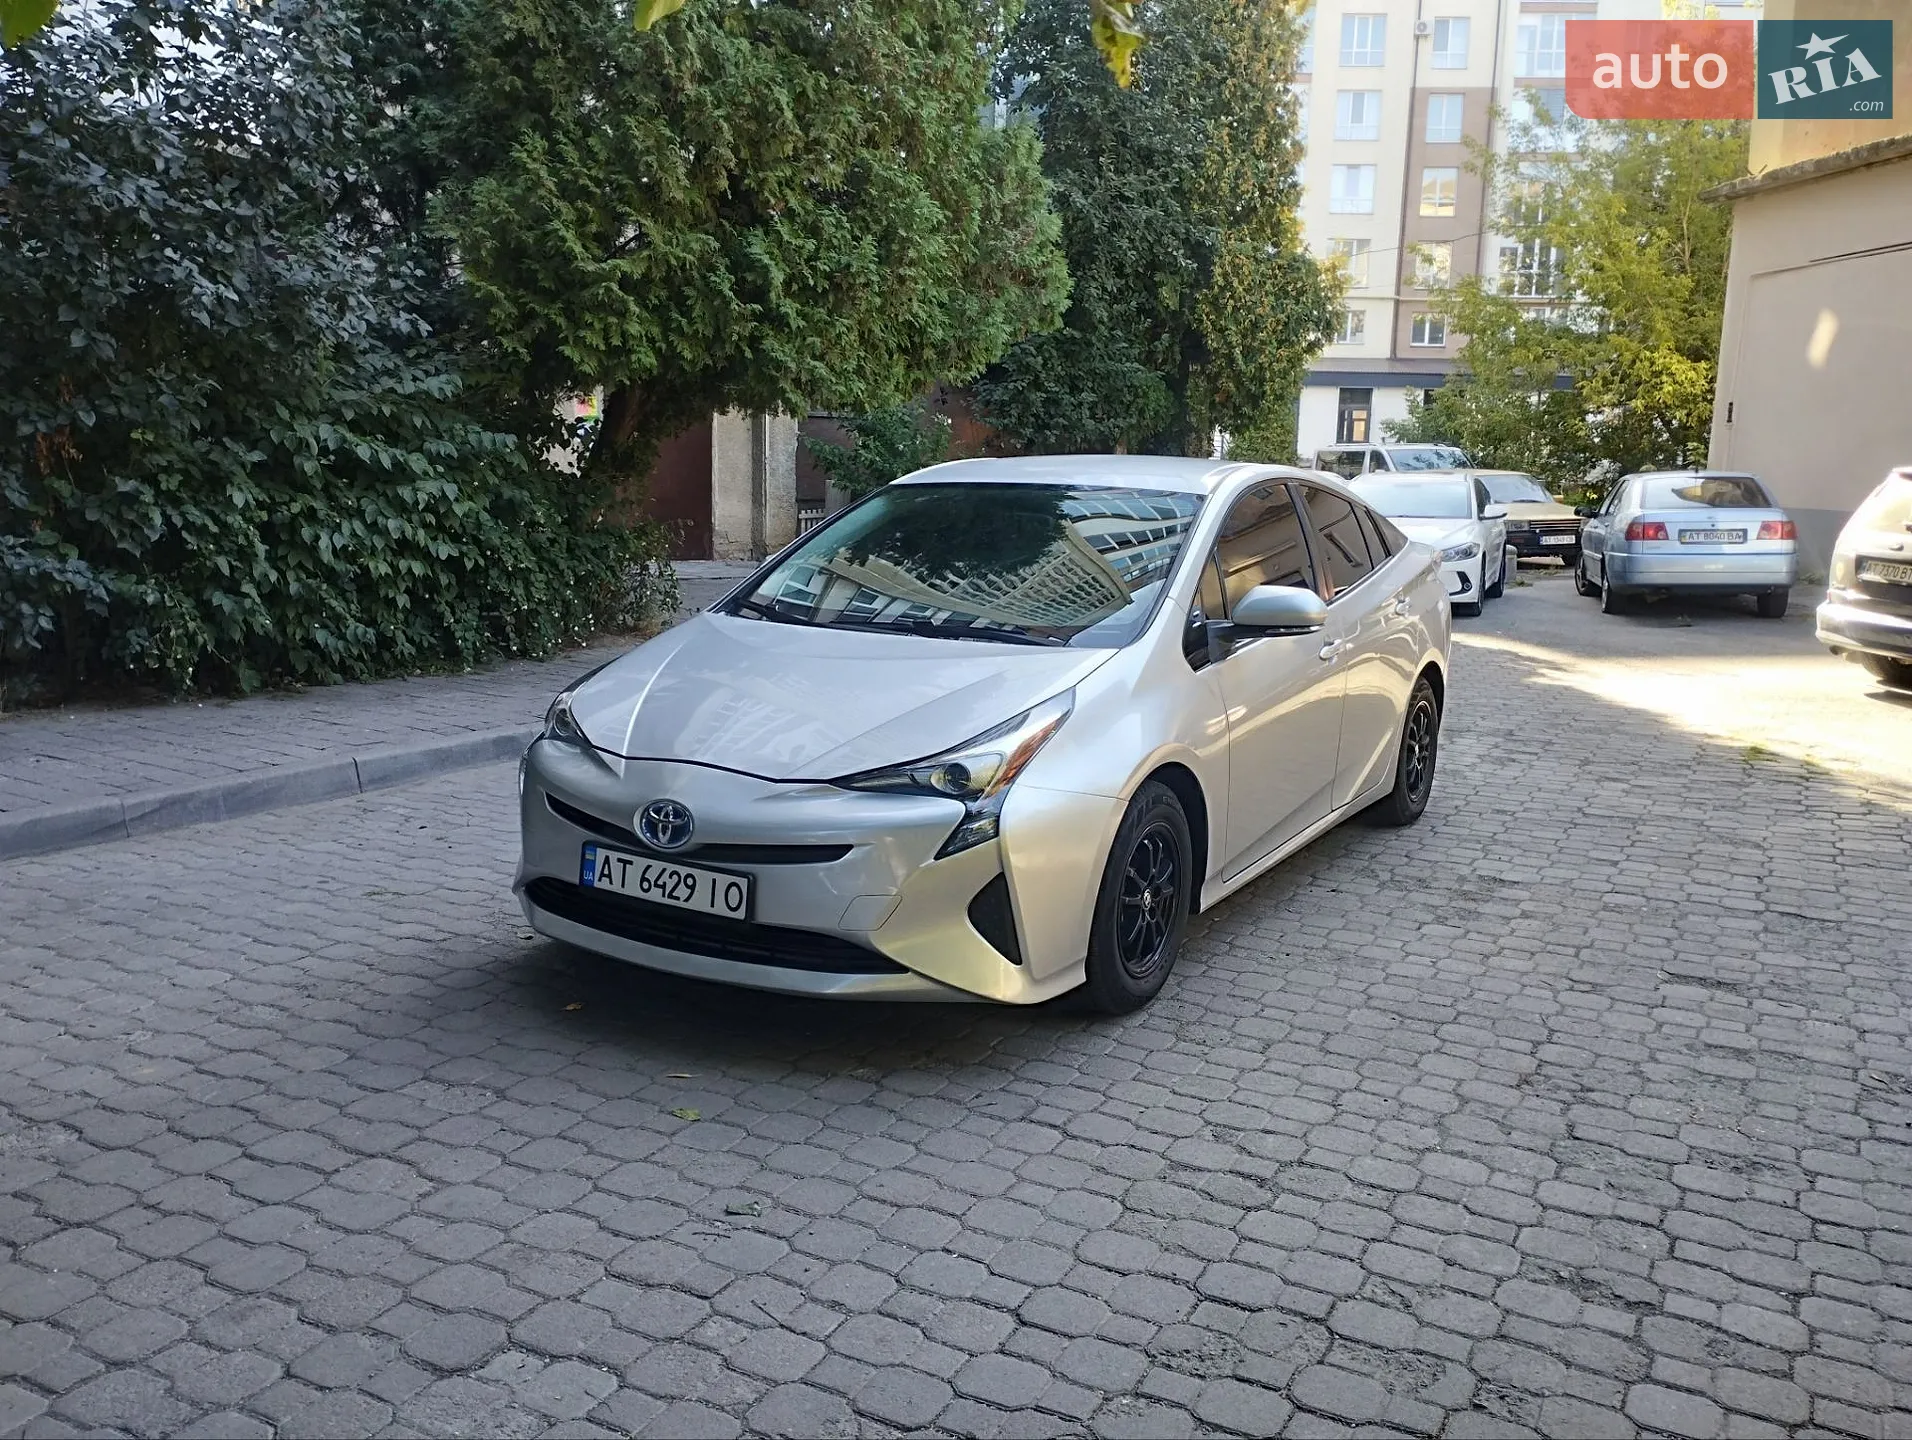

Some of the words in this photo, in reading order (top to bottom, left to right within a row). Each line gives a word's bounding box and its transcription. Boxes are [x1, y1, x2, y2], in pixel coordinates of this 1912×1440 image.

[1688, 532, 1700, 541] AT
[1727, 532, 1741, 541] BA
[1864, 562, 1880, 576] AT
[583, 870, 594, 881] UA
[597, 854, 634, 889] AT
[639, 864, 697, 903] 6429
[709, 877, 744, 913] IO
